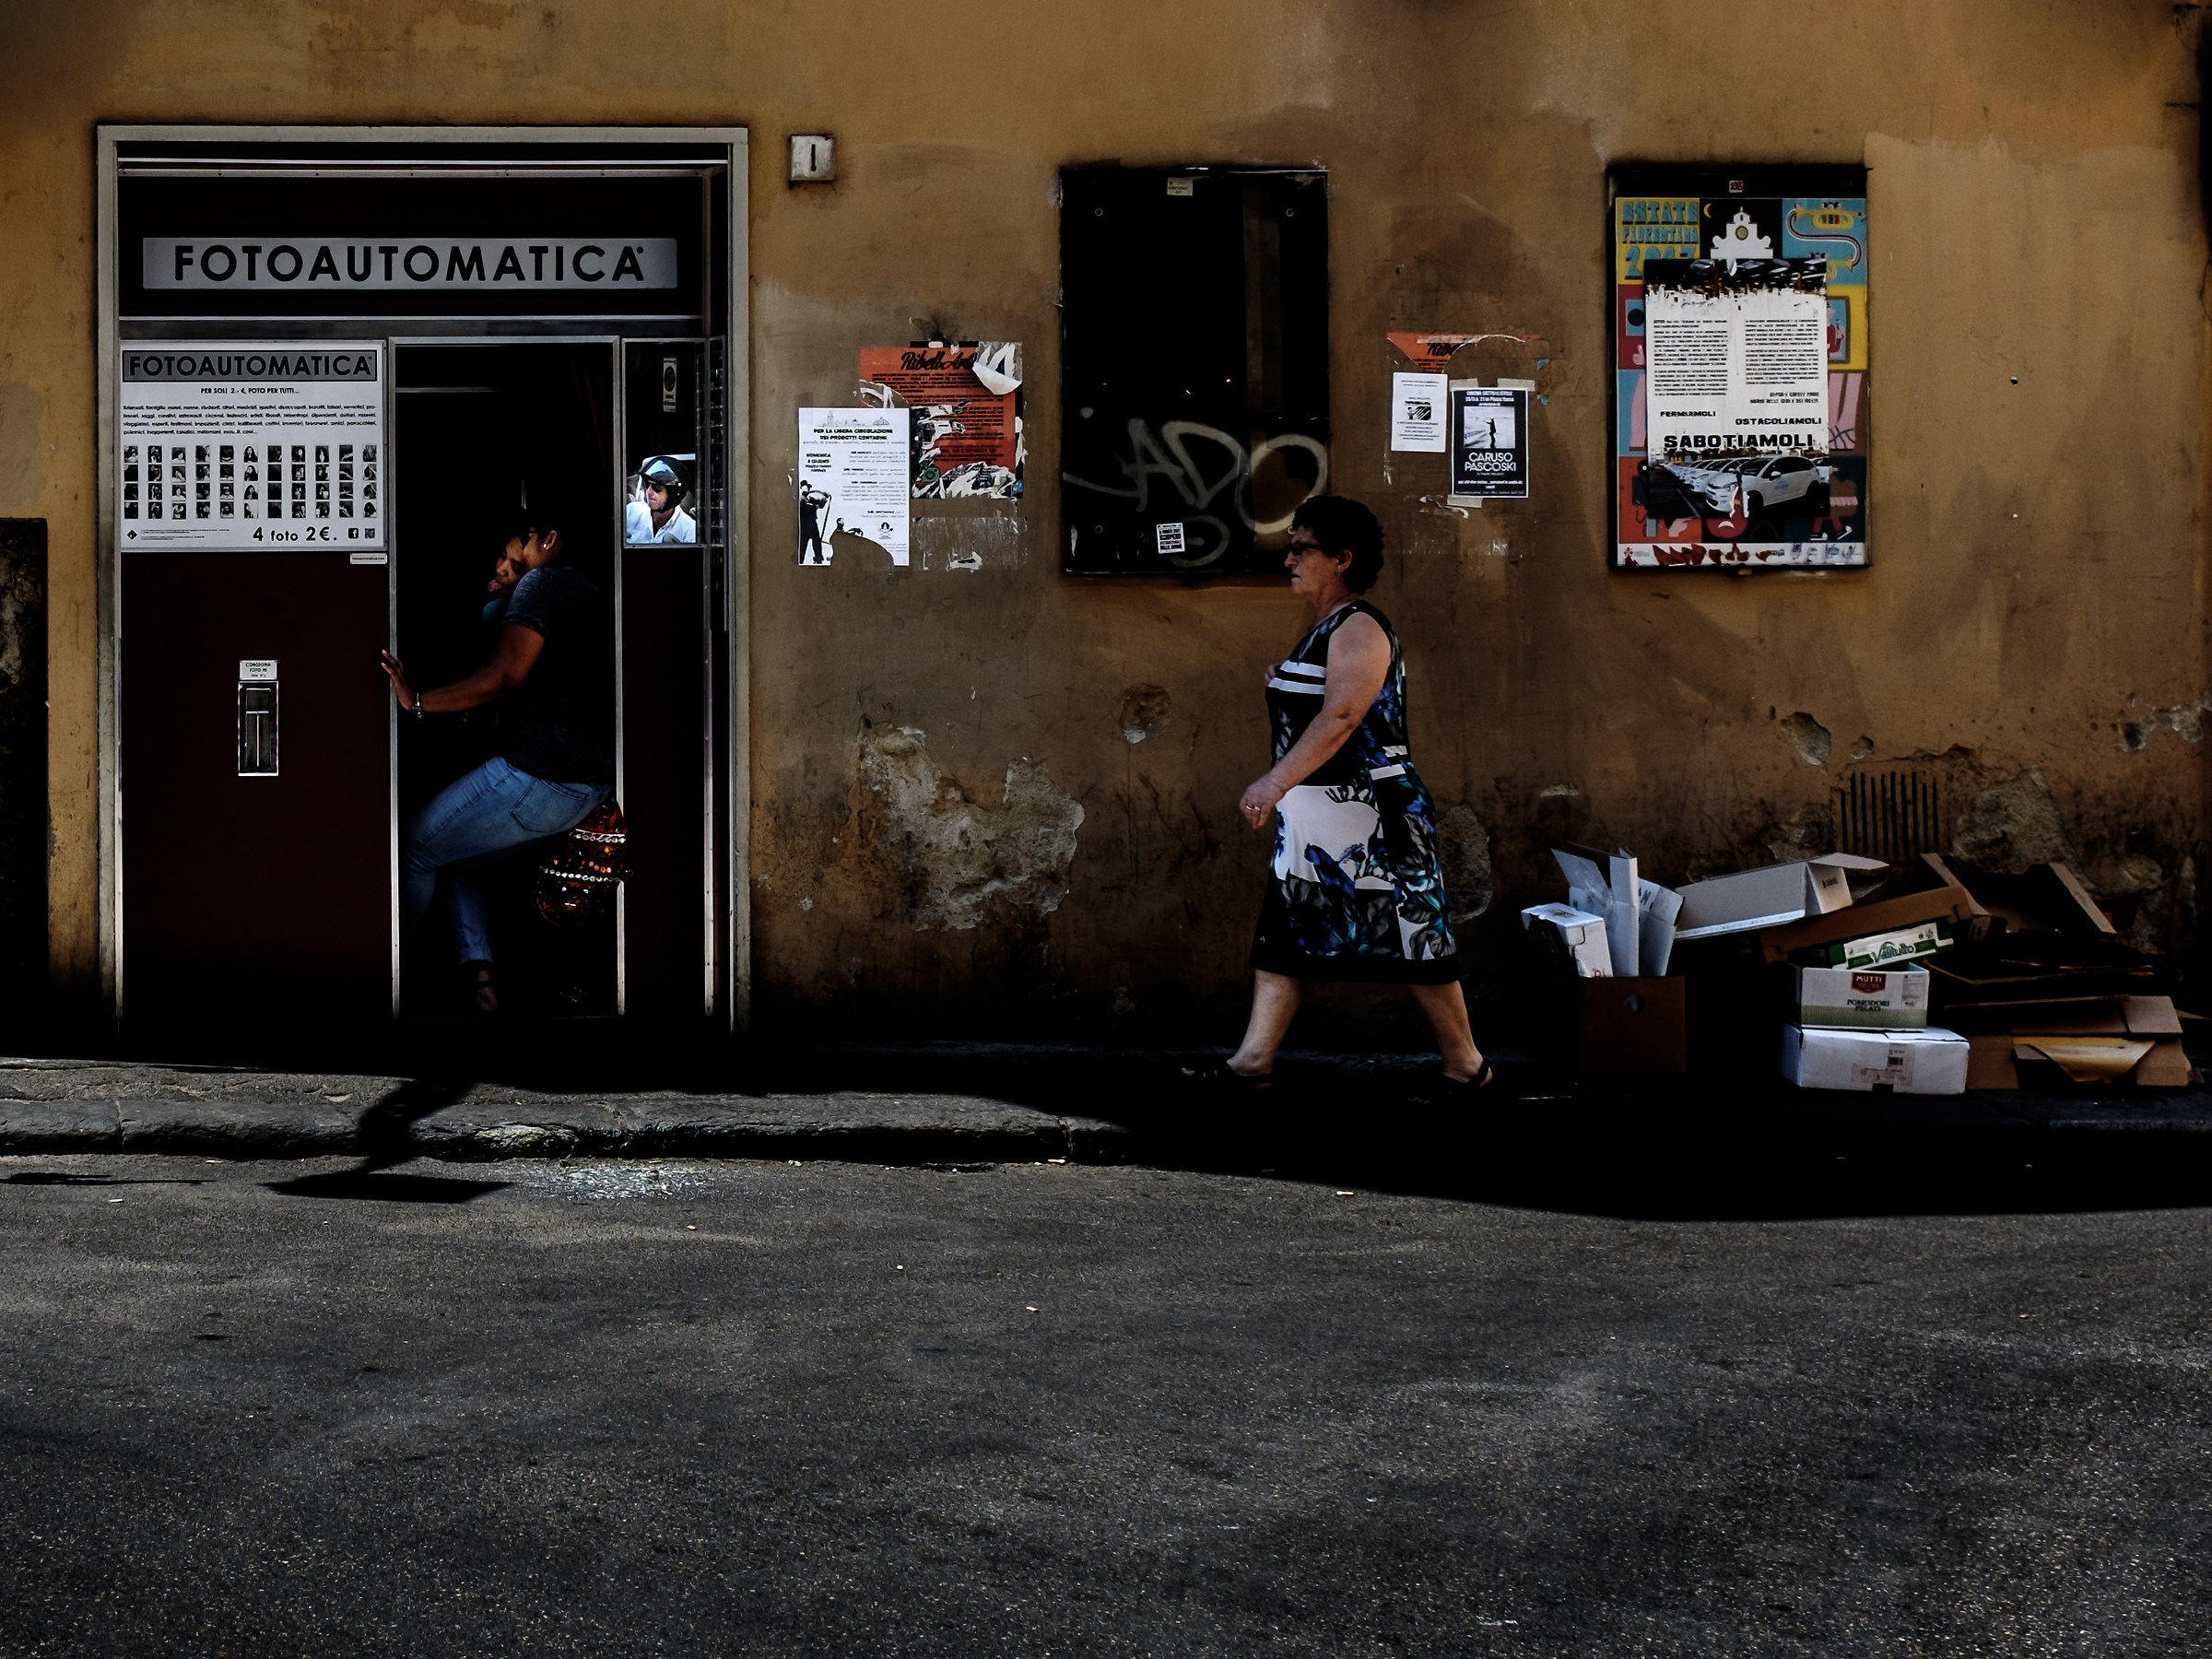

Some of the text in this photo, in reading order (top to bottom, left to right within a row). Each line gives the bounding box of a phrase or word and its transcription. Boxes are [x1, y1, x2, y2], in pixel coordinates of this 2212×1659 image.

[174, 244, 644, 282] FOTOAUTOMATICA
[129, 355, 372, 377] FOTOAUTOMATICA
[1735, 418, 1822, 426] OSTACOLIAMOLI
[1663, 434, 1814, 449] SABOTIAMOLI
[1468, 453, 1513, 463] CARUSO
[1464, 462, 1517, 472] PASCOSKI
[252, 526, 264, 542] 4
[270, 530, 299, 542] foto
[1855, 975, 1883, 983] MUTTI
